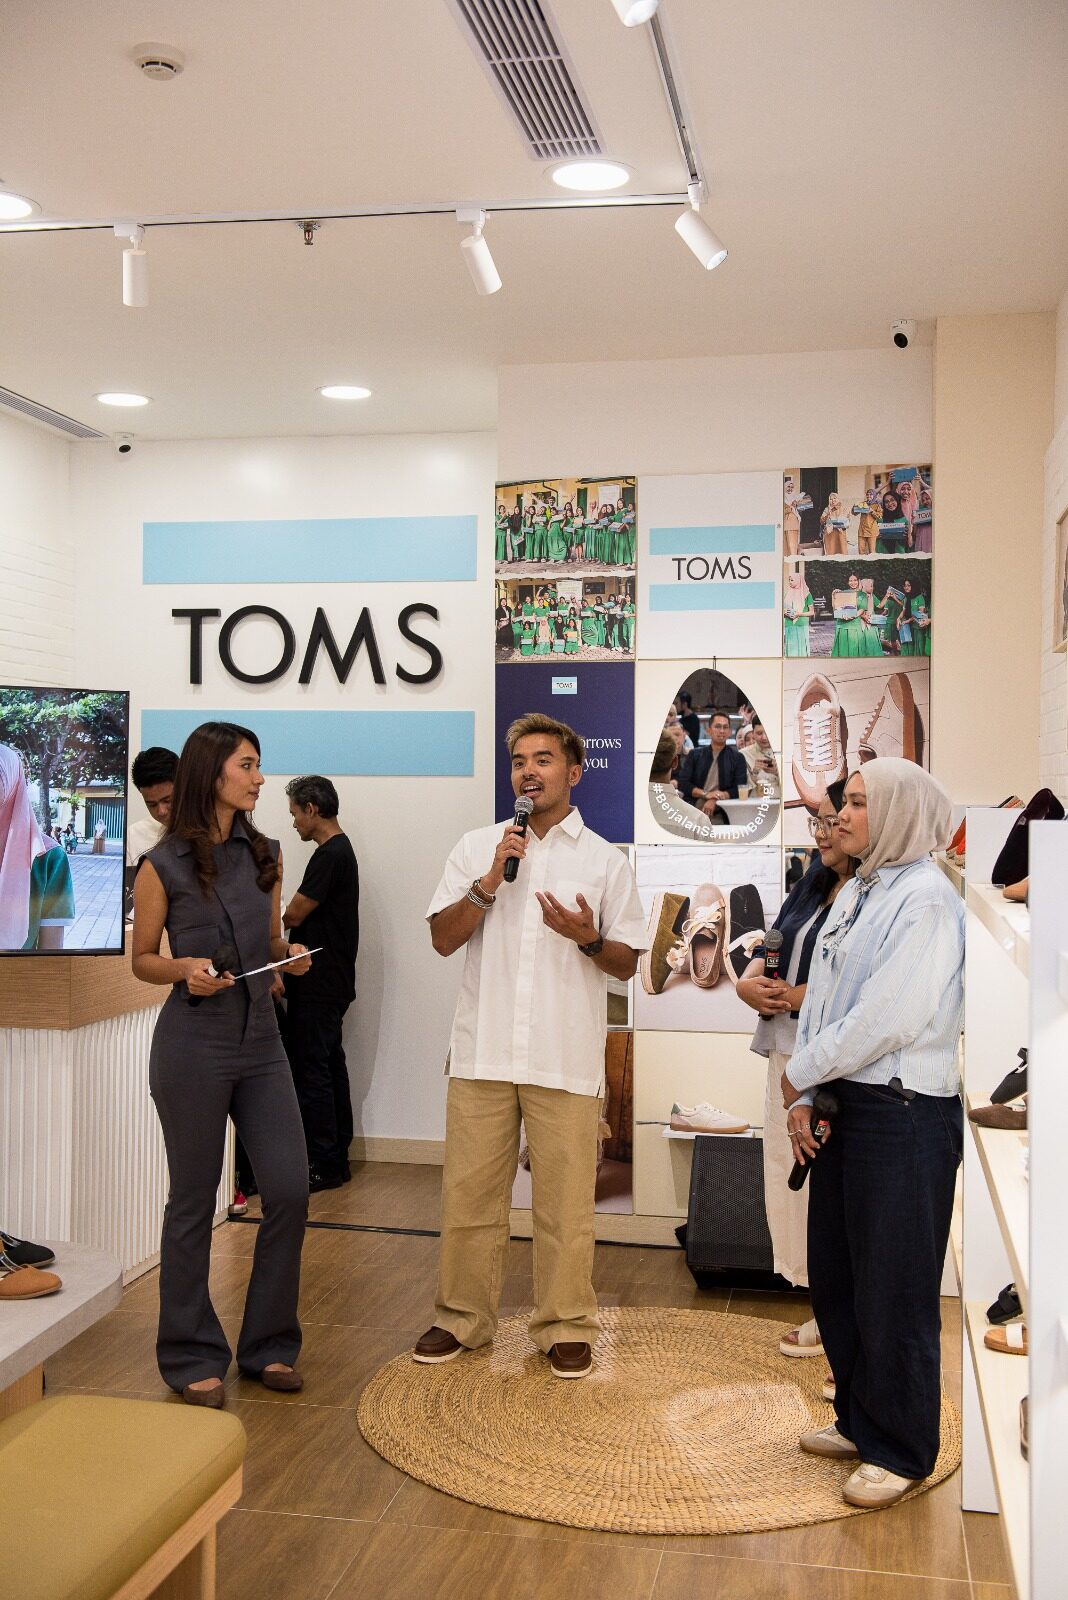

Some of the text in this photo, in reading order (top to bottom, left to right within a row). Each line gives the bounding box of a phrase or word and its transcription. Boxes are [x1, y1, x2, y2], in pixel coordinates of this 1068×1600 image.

[671, 555, 752, 581] TOMS
[171, 602, 443, 684] TOMS
[580, 738, 622, 749] orrows
[583, 757, 608, 772] you
